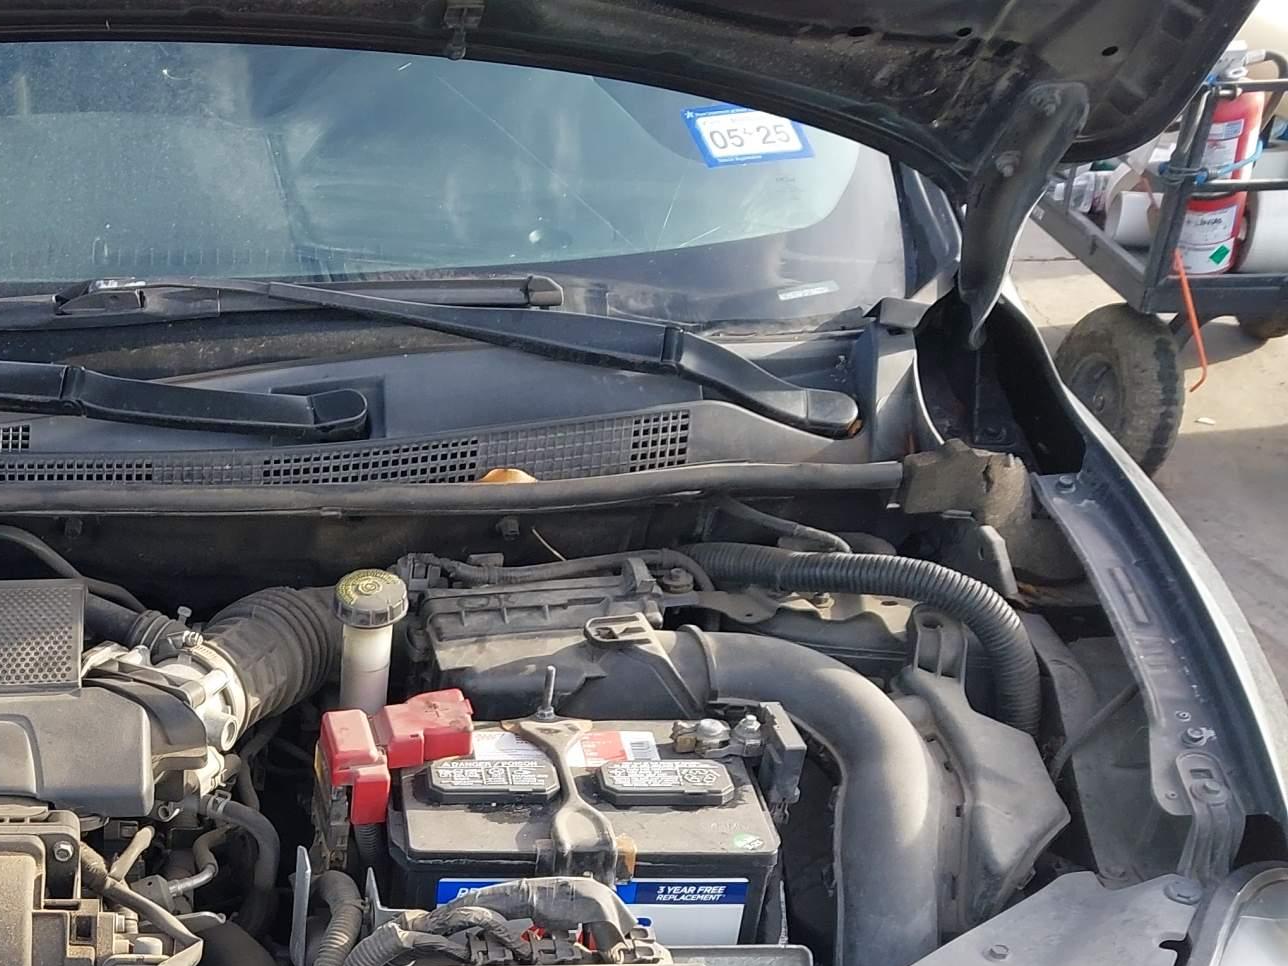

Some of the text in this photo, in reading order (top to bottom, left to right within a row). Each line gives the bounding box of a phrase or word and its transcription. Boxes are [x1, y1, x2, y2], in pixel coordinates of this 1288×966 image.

[709, 124, 791, 150] 05 25
[657, 885, 727, 894] 3 YEAR FREE
